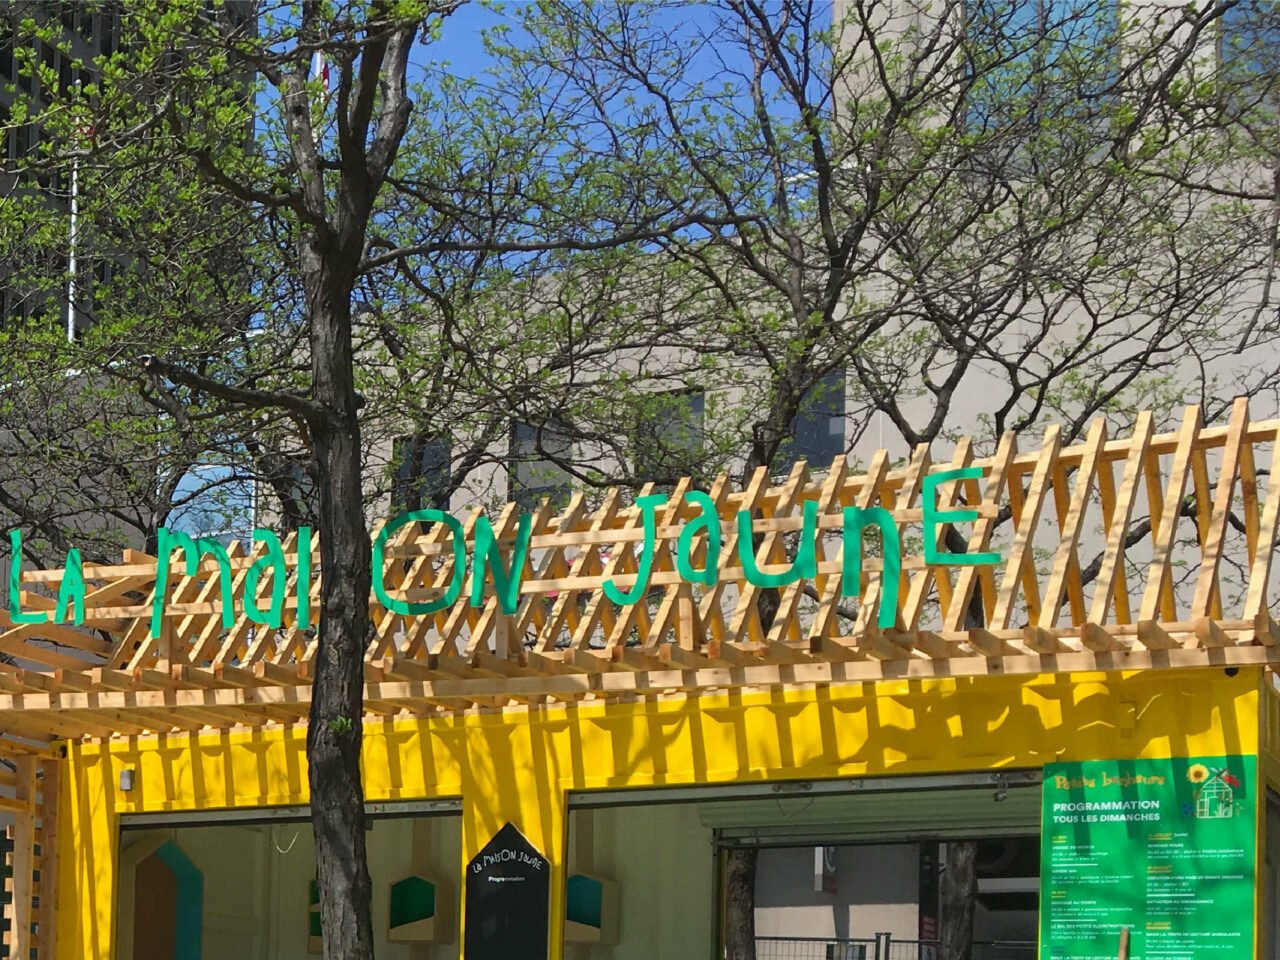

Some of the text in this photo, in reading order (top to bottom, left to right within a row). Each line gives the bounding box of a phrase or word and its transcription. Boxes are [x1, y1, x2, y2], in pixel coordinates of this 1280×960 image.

[10, 528, 86, 626] LA
[1053, 800, 1160, 812] PROGRAMMATION
[1053, 812, 1161, 824] TOUS LES DIMANCHES
